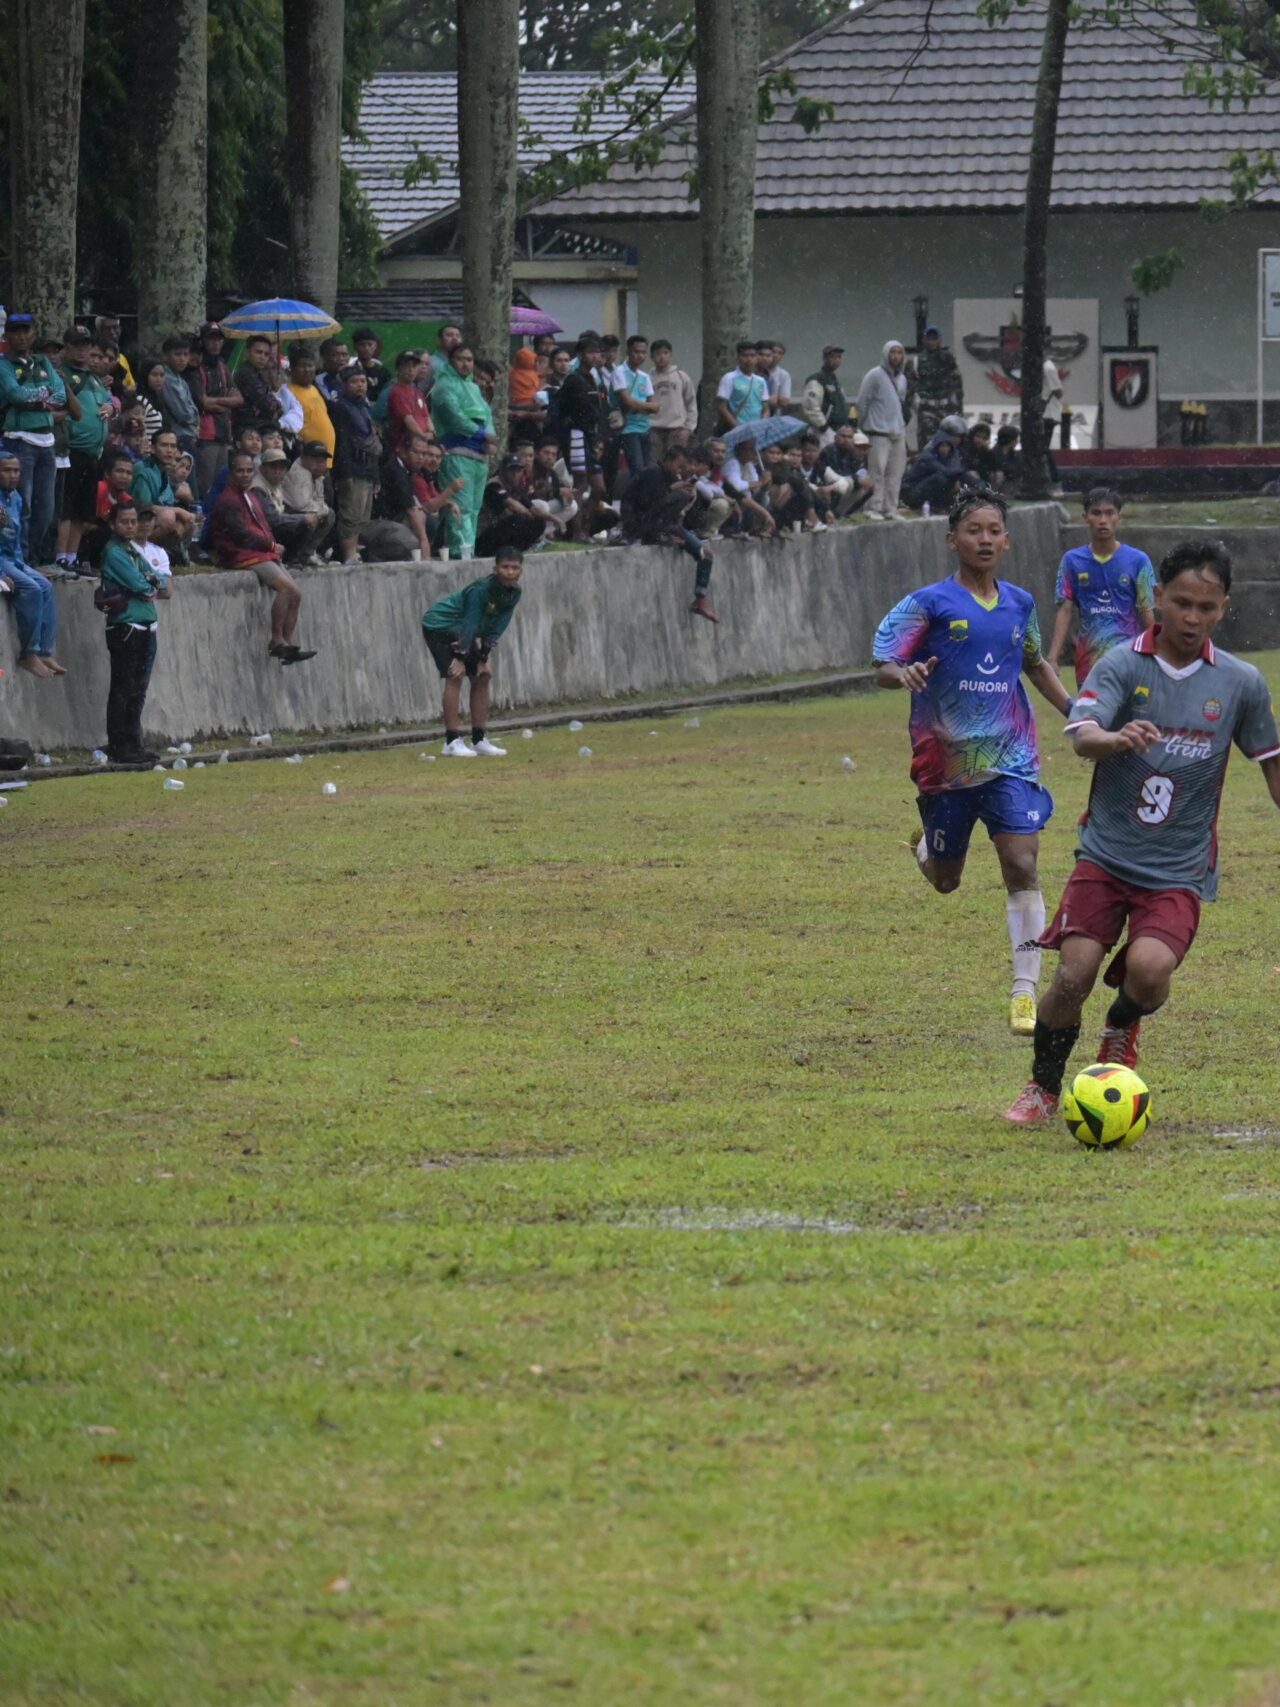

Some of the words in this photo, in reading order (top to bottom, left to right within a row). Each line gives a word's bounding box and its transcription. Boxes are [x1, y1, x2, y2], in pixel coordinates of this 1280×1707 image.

[959, 680, 1008, 693] AURORA
[1136, 774, 1175, 825] 9
[933, 828, 946, 852] 6
